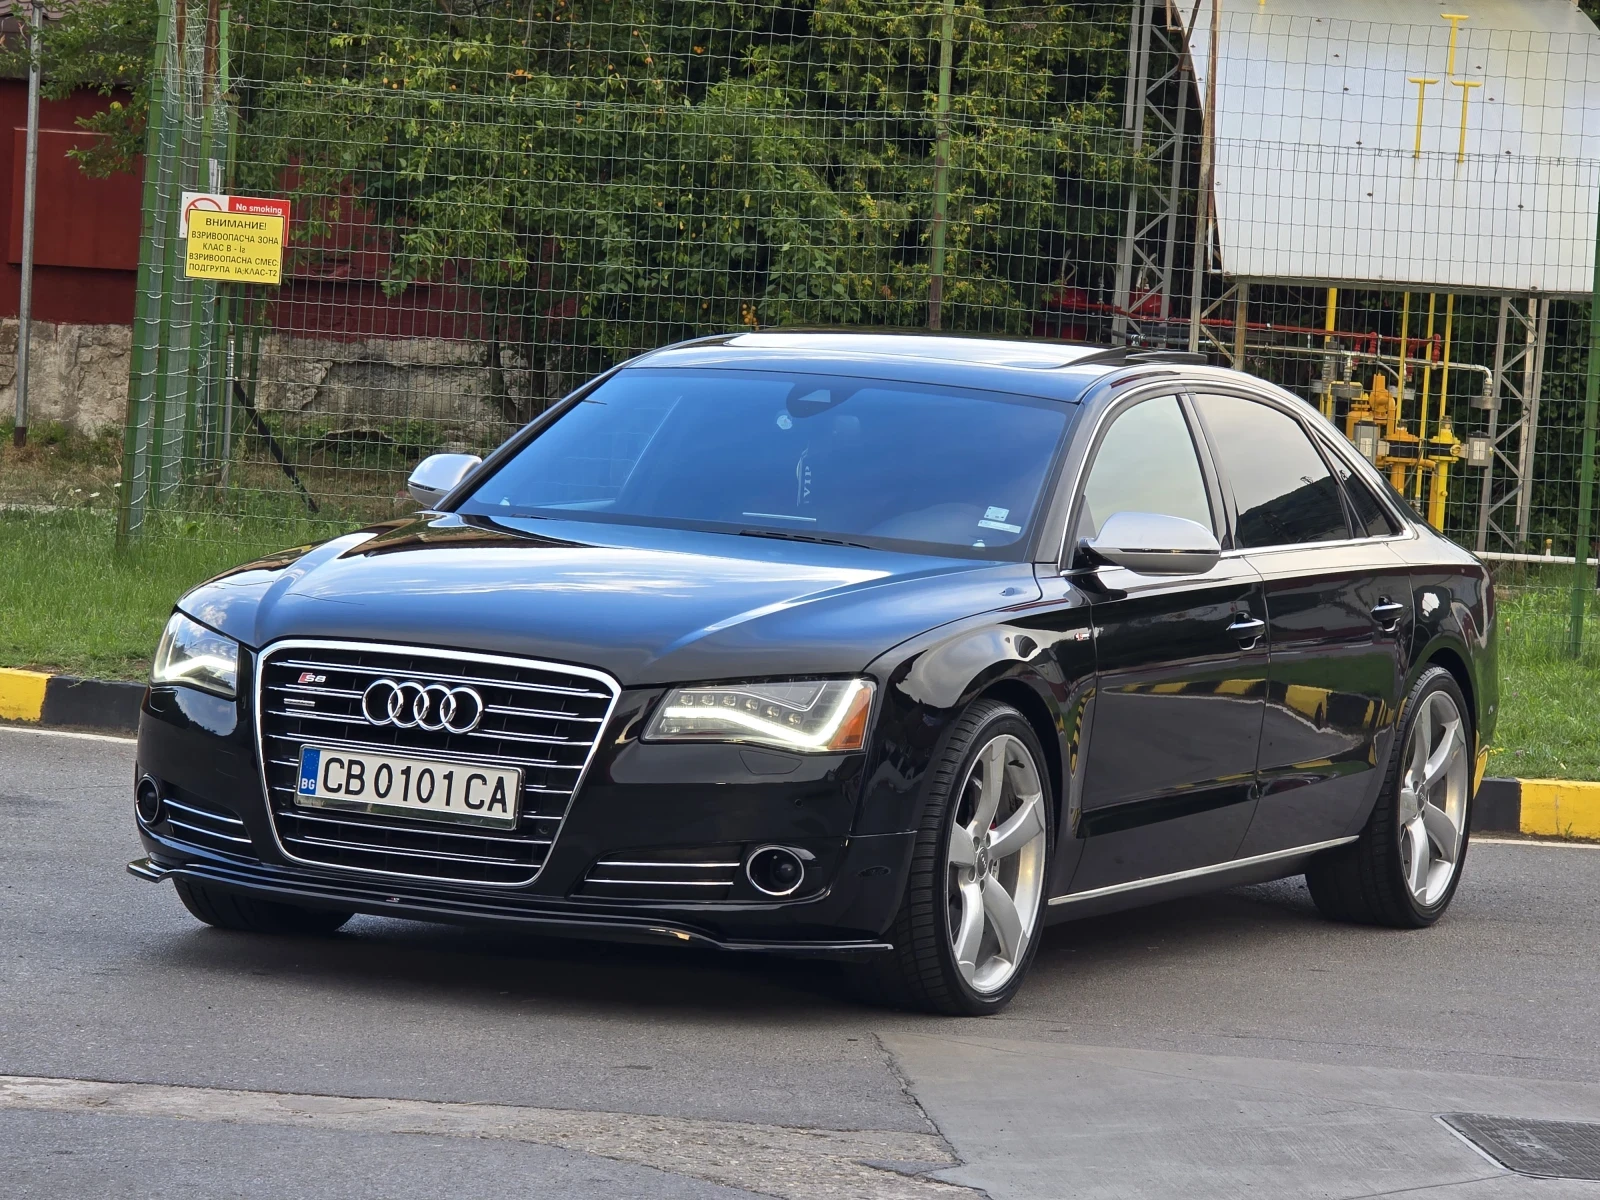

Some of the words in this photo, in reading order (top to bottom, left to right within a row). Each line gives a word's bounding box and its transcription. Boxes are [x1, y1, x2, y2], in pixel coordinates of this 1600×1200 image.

[235, 203, 247, 211] No
[249, 205, 282, 215] smoking
[205, 217, 267, 230] ВНИМАНИЕ!
[257, 236, 279, 245] ЗОНА
[202, 243, 224, 251] КЛАС
[189, 252, 253, 264] ВЗРИВООПАСНА
[188, 263, 230, 273] ПОДГРУПА
[303, 674, 326, 682] S8
[301, 778, 315, 790] BG
